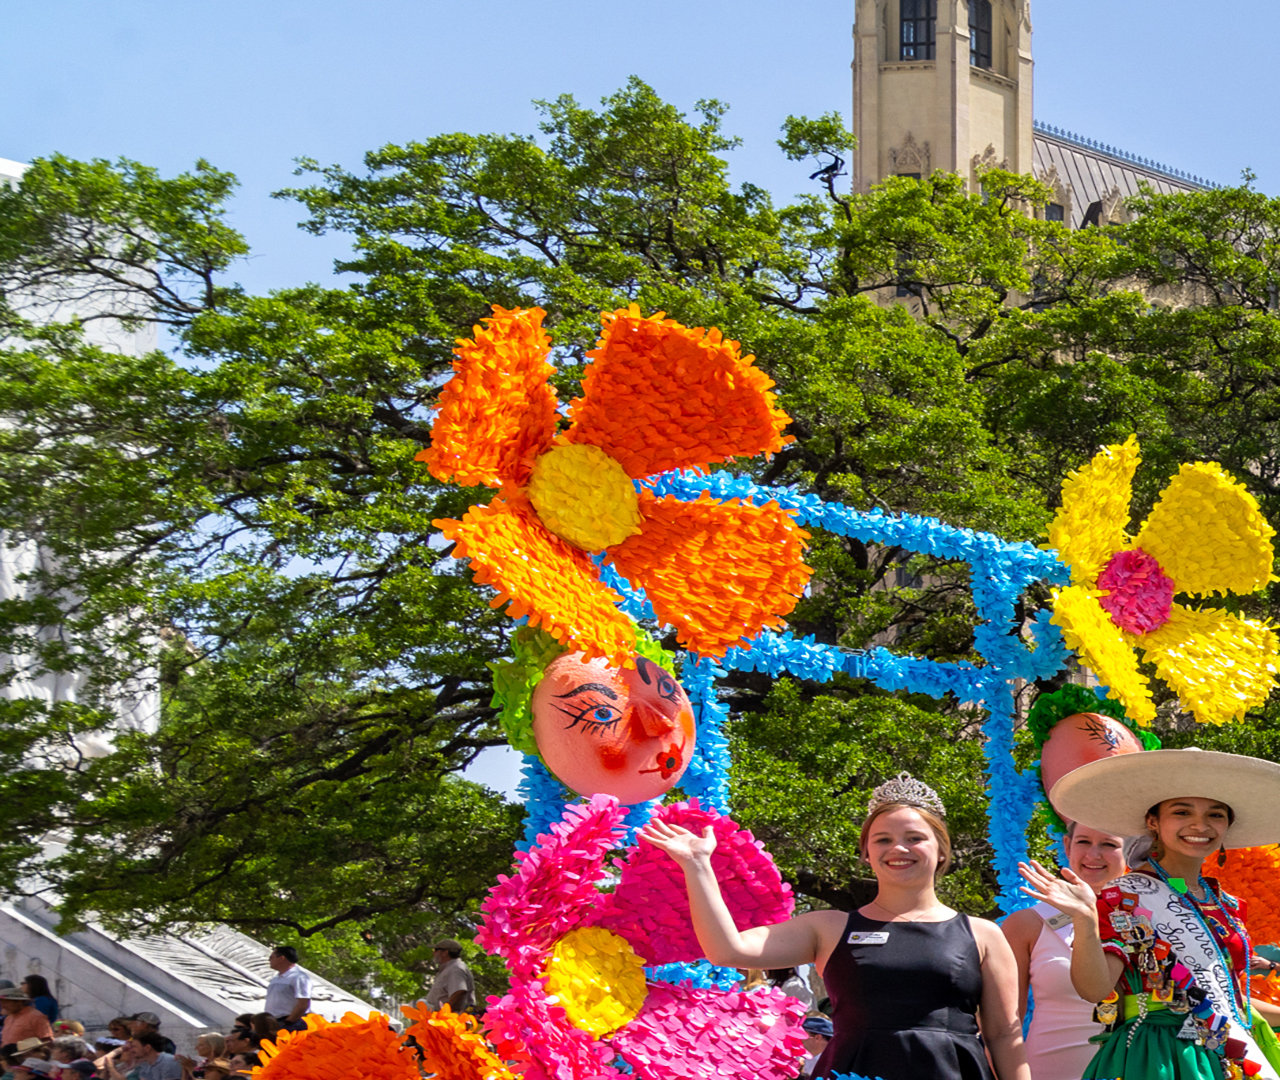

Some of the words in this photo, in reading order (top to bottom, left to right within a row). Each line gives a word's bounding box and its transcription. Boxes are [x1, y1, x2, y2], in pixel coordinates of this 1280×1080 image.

[1167, 894, 1214, 959] Charro
[1156, 922, 1186, 951] San
[1184, 955, 1222, 1013] Antonio
